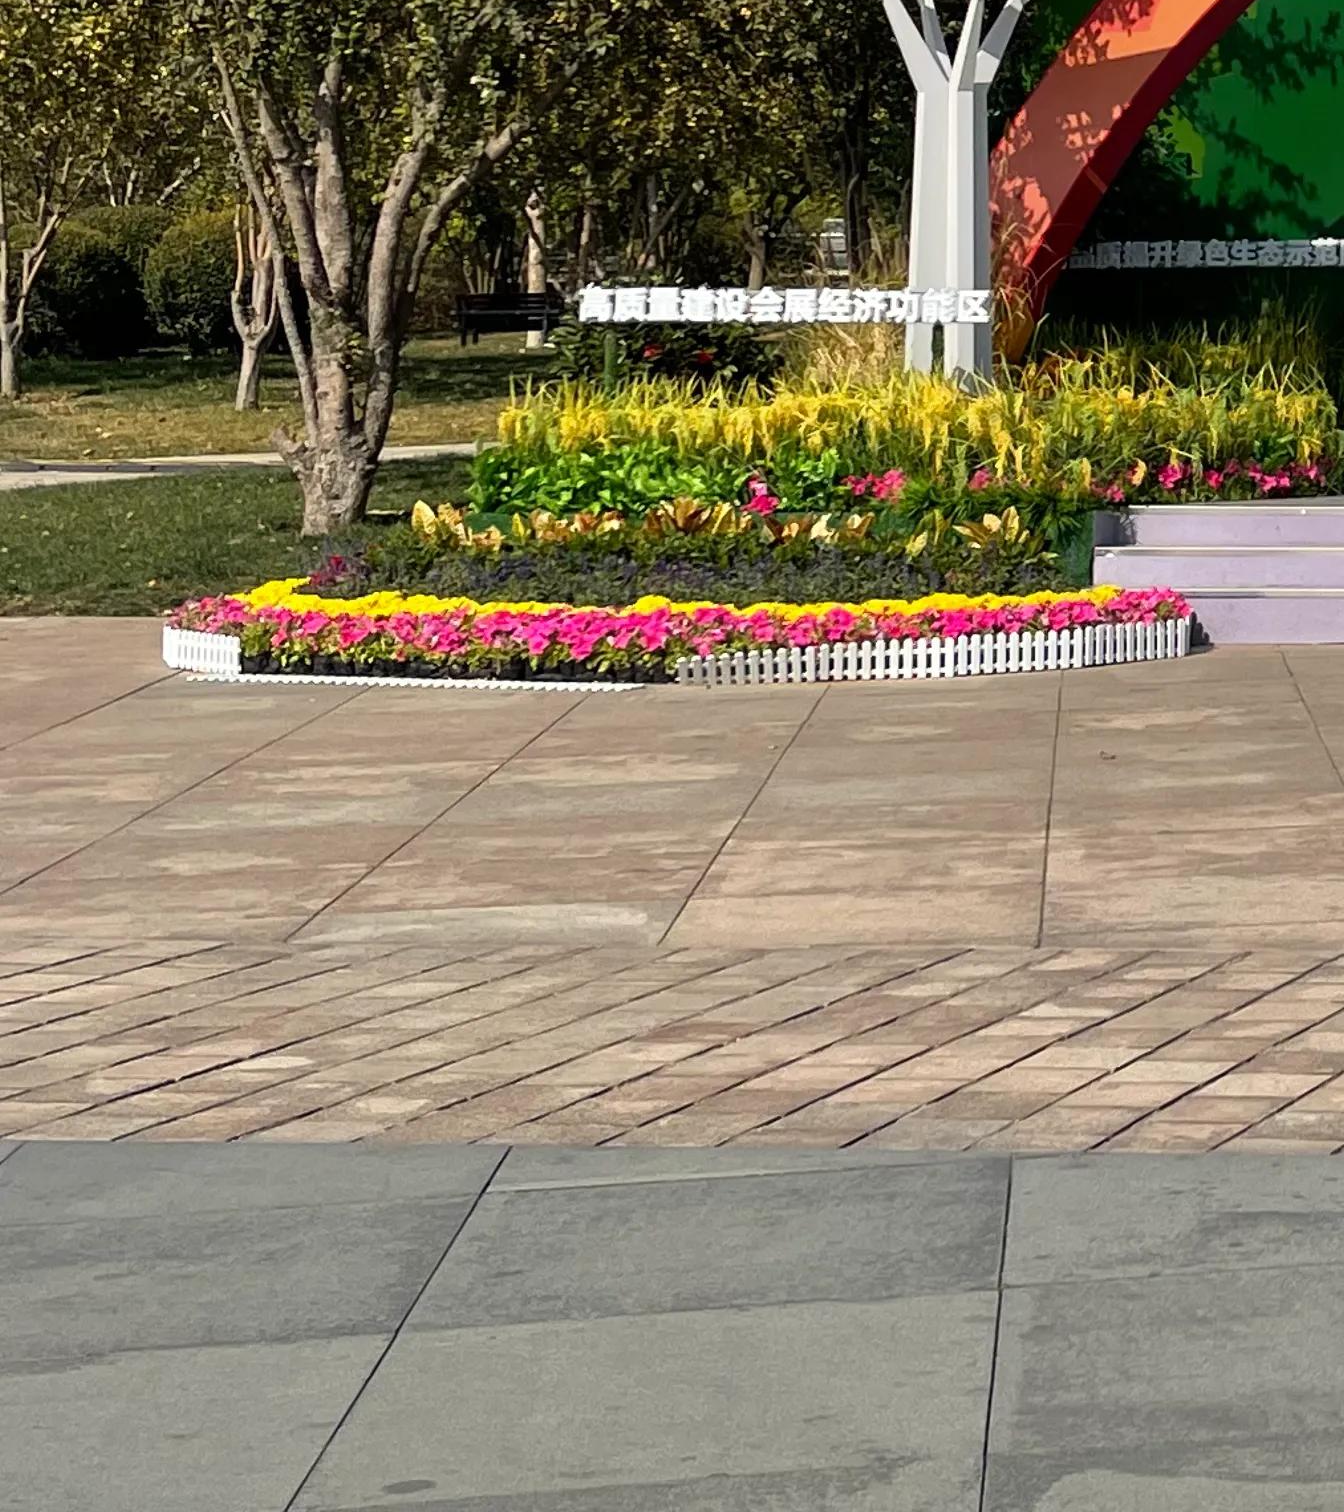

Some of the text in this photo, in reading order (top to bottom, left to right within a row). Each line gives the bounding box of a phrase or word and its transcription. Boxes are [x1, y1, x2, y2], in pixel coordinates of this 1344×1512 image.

[577, 283, 993, 324] 高质量建设会展经济功能区
